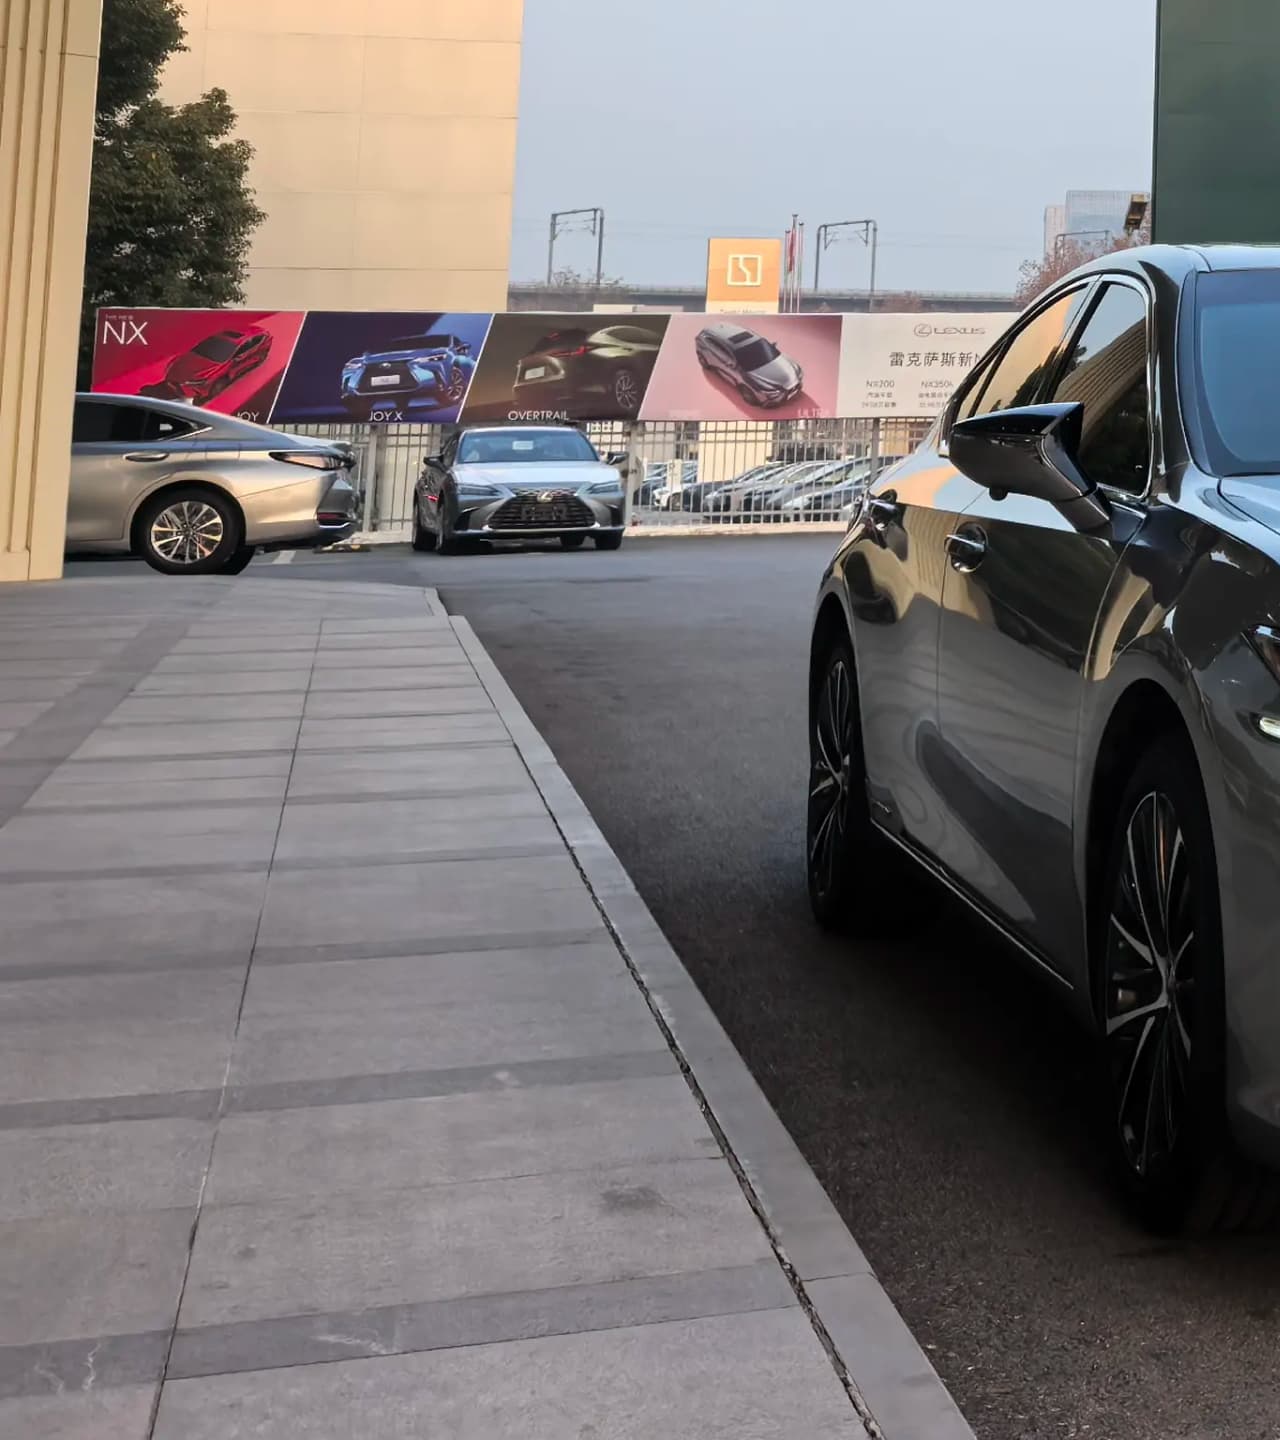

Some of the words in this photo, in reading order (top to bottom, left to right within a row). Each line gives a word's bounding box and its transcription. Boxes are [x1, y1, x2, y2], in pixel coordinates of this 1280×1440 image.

[103, 321, 149, 345] NX
[934, 327, 986, 335] LEXUS
[368, 411, 390, 422] JOY
[393, 411, 403, 421] X
[508, 410, 569, 421] OVERTRAIL
